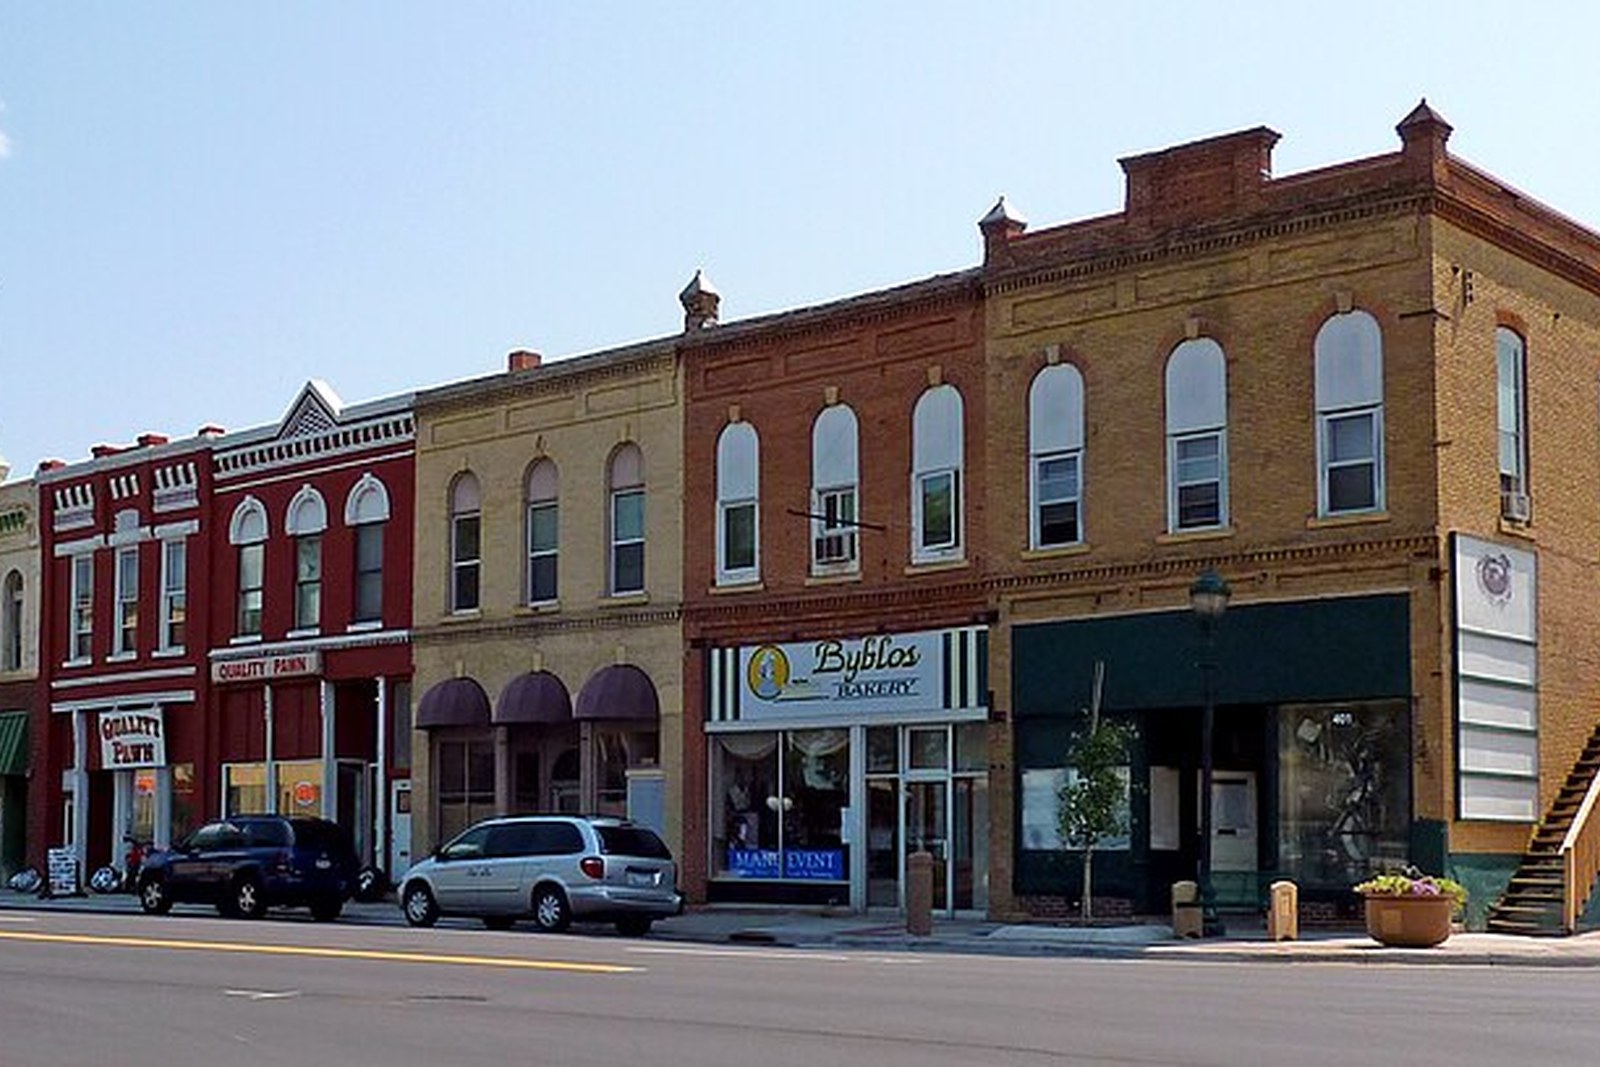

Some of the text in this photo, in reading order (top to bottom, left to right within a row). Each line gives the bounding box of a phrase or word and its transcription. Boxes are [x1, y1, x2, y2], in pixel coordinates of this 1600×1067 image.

[220, 656, 307, 679] QUALITY PAWN
[812, 635, 921, 682] Byblos
[835, 679, 917, 698] BAKERY
[103, 715, 160, 740] QUALITY
[112, 741, 154, 764] PAWN
[786, 851, 835, 869] EVENT
